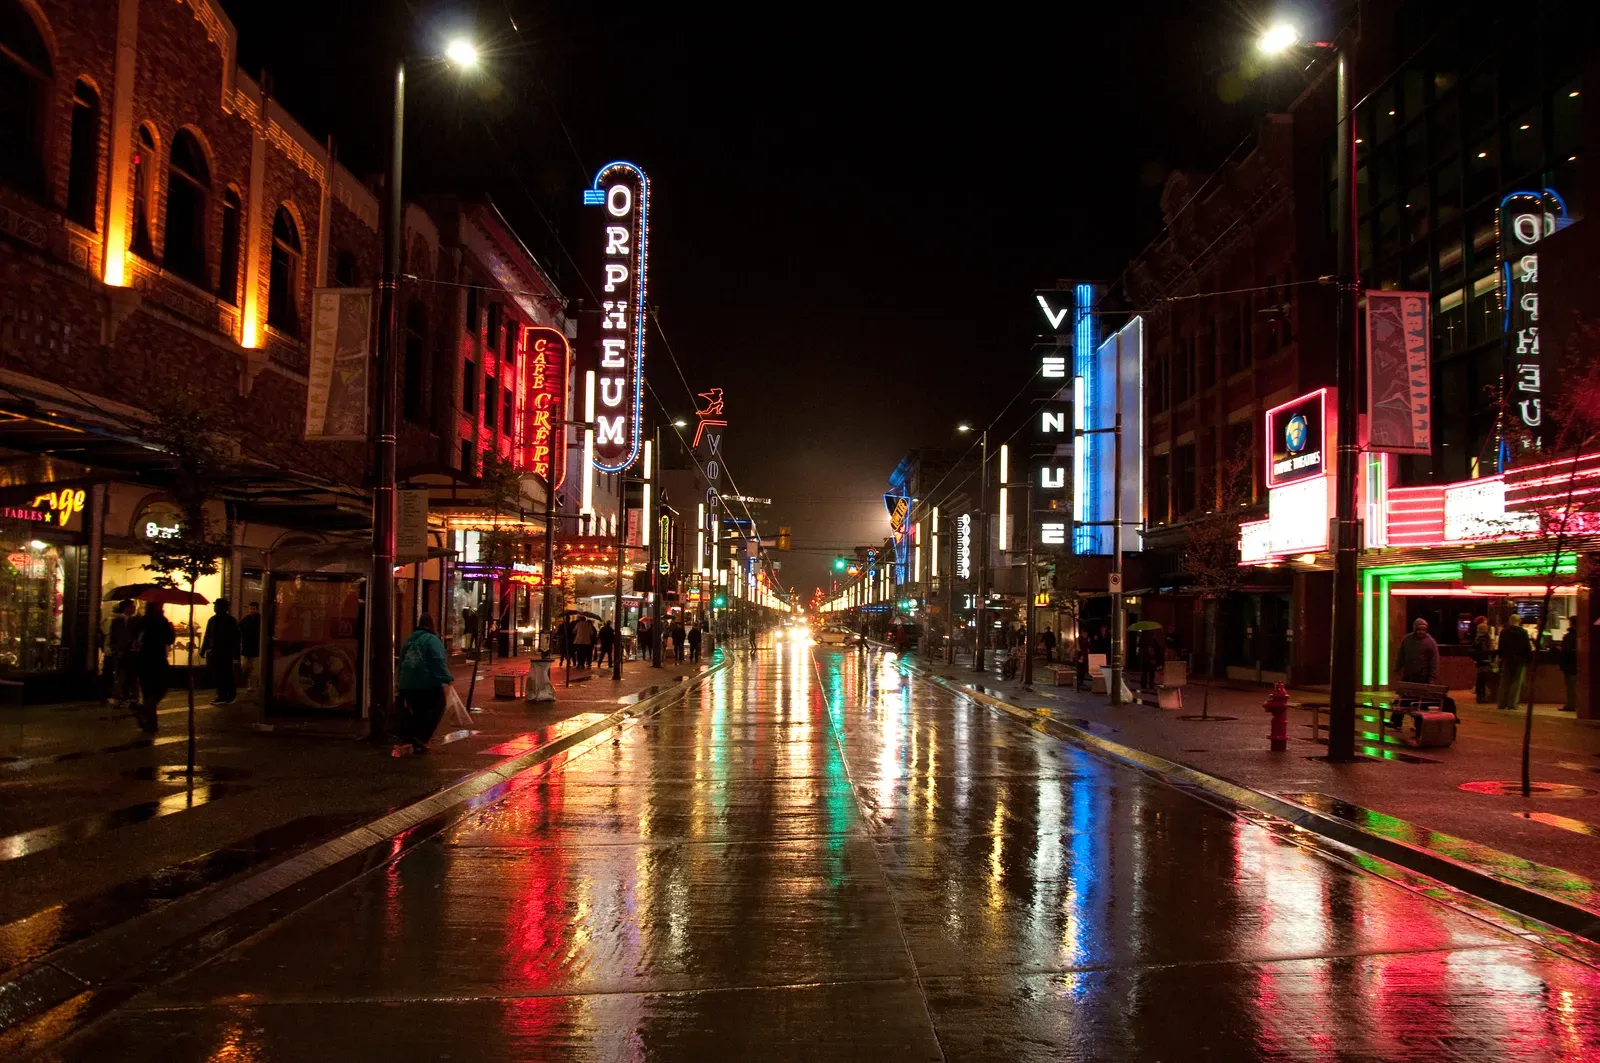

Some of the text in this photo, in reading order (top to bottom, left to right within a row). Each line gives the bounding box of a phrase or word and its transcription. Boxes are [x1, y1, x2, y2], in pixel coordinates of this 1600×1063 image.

[597, 184, 632, 445] ORPHEUM
[1036, 295, 1067, 544] VENUE
[1405, 297, 1428, 443] GRANVILLE
